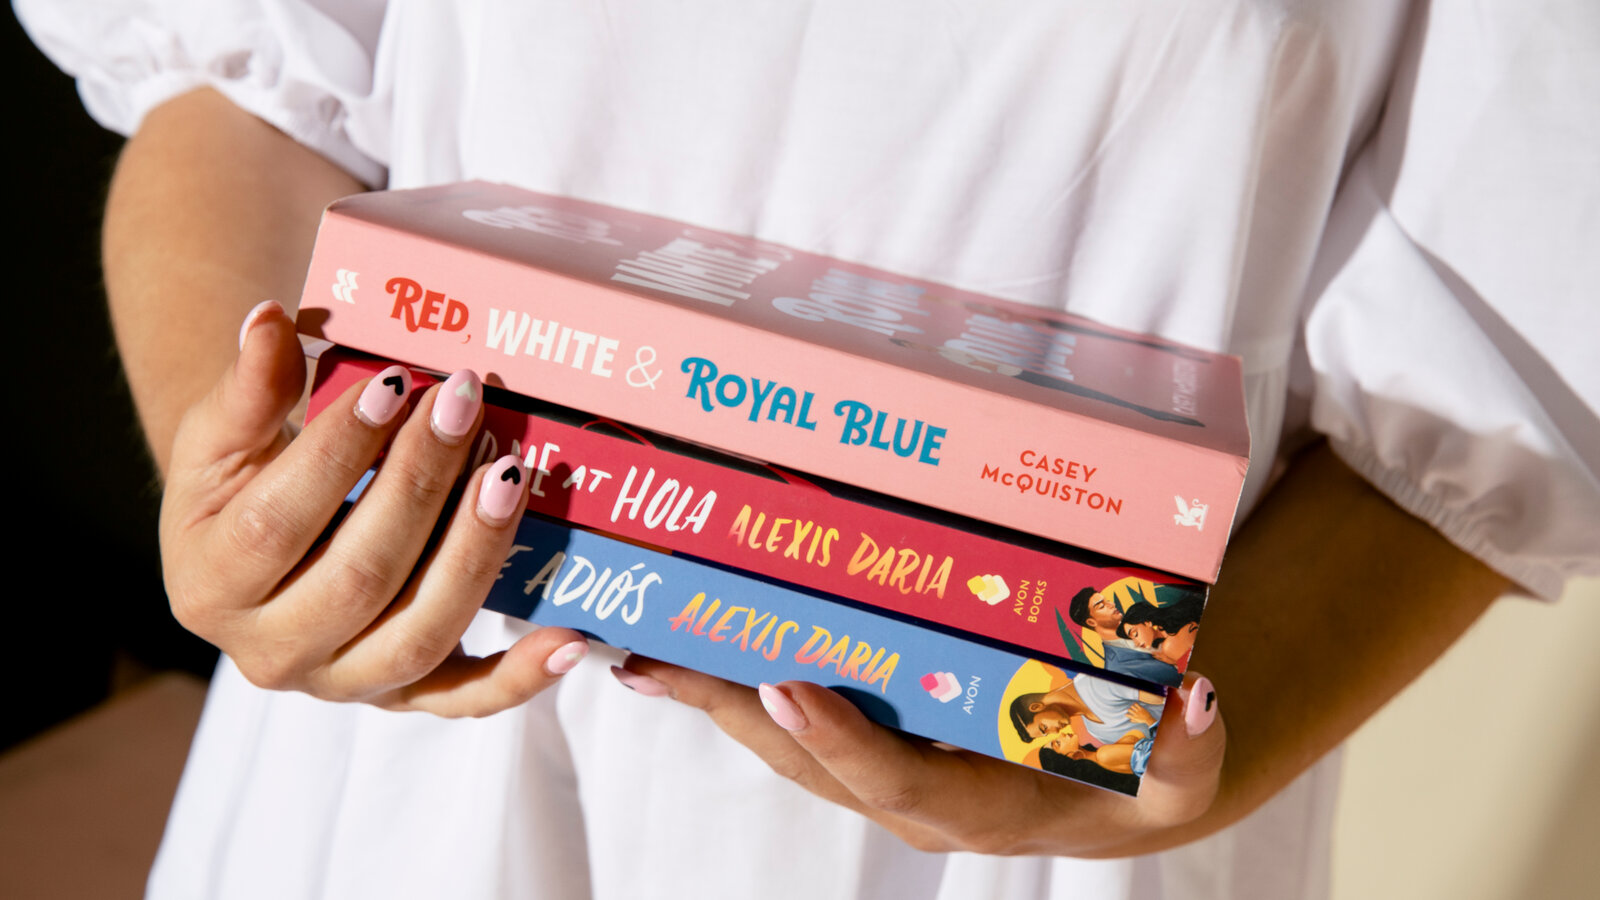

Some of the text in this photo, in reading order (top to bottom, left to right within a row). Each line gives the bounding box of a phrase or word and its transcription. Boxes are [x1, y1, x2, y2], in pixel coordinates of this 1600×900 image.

[385, 277, 947, 466] RED, WHITE & ROYAL BLUE
[981, 464, 1123, 515] McQUISTON
[1020, 450, 1097, 483] CASEY
[562, 465, 612, 493] AT
[610, 465, 717, 534] HOLA
[727, 504, 954, 600] ALEXIS DARIA
[523, 551, 662, 625] ADIÓS
[1013, 579, 1030, 615] AVON
[1027, 580, 1047, 623] BOOKS
[668, 592, 900, 694] ALEXIS DARIA
[962, 675, 982, 715] AVON
